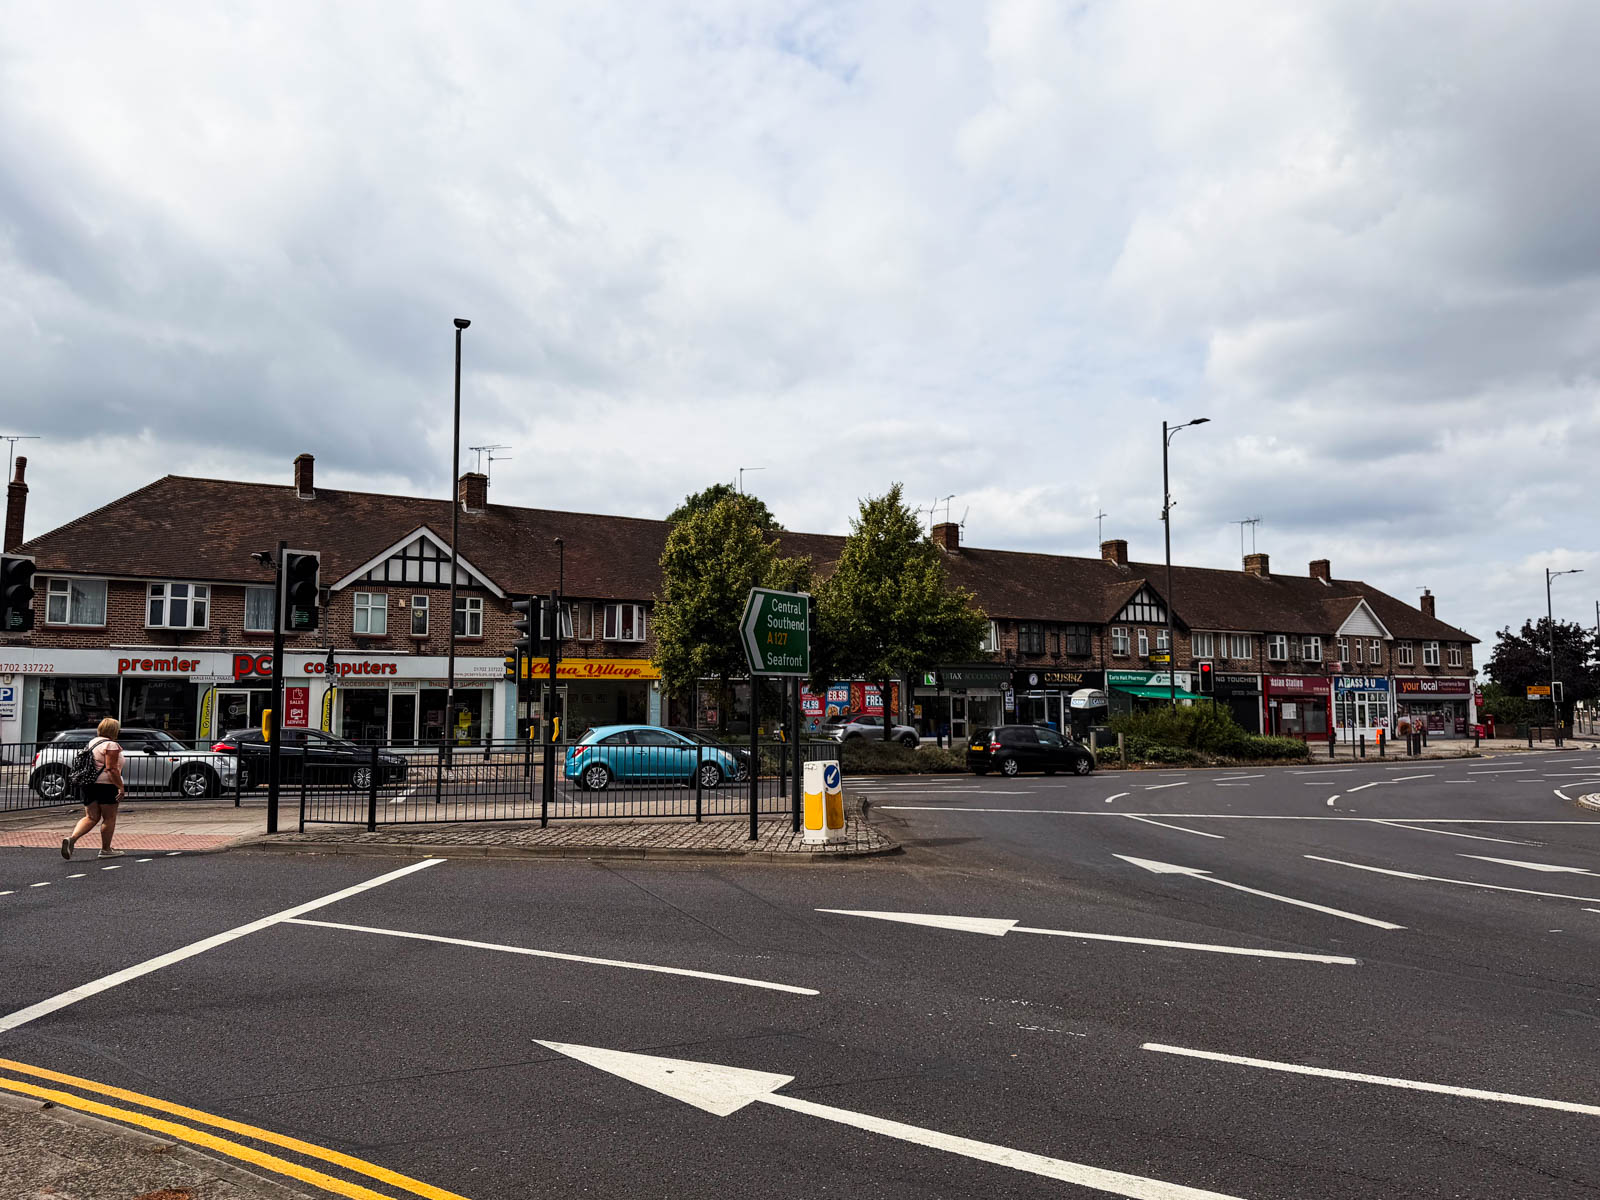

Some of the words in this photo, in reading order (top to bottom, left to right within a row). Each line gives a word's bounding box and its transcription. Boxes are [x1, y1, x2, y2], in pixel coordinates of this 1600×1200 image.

[772, 598, 801, 615] Central
[767, 614, 804, 631] Southend
[767, 631, 788, 646] A127
[118, 656, 200, 674] premier
[767, 652, 802, 667] Seafront
[22, 663, 55, 673] 337222
[532, 662, 580, 675] Chna
[583, 663, 642, 677] Village
[1227, 676, 1257, 684] TOUCHES
[1370, 678, 1376, 688] U
[1402, 681, 1420, 693] your
[1420, 680, 1438, 691] local
[828, 690, 847, 701] £8.99
[802, 700, 819, 710] £4.99
